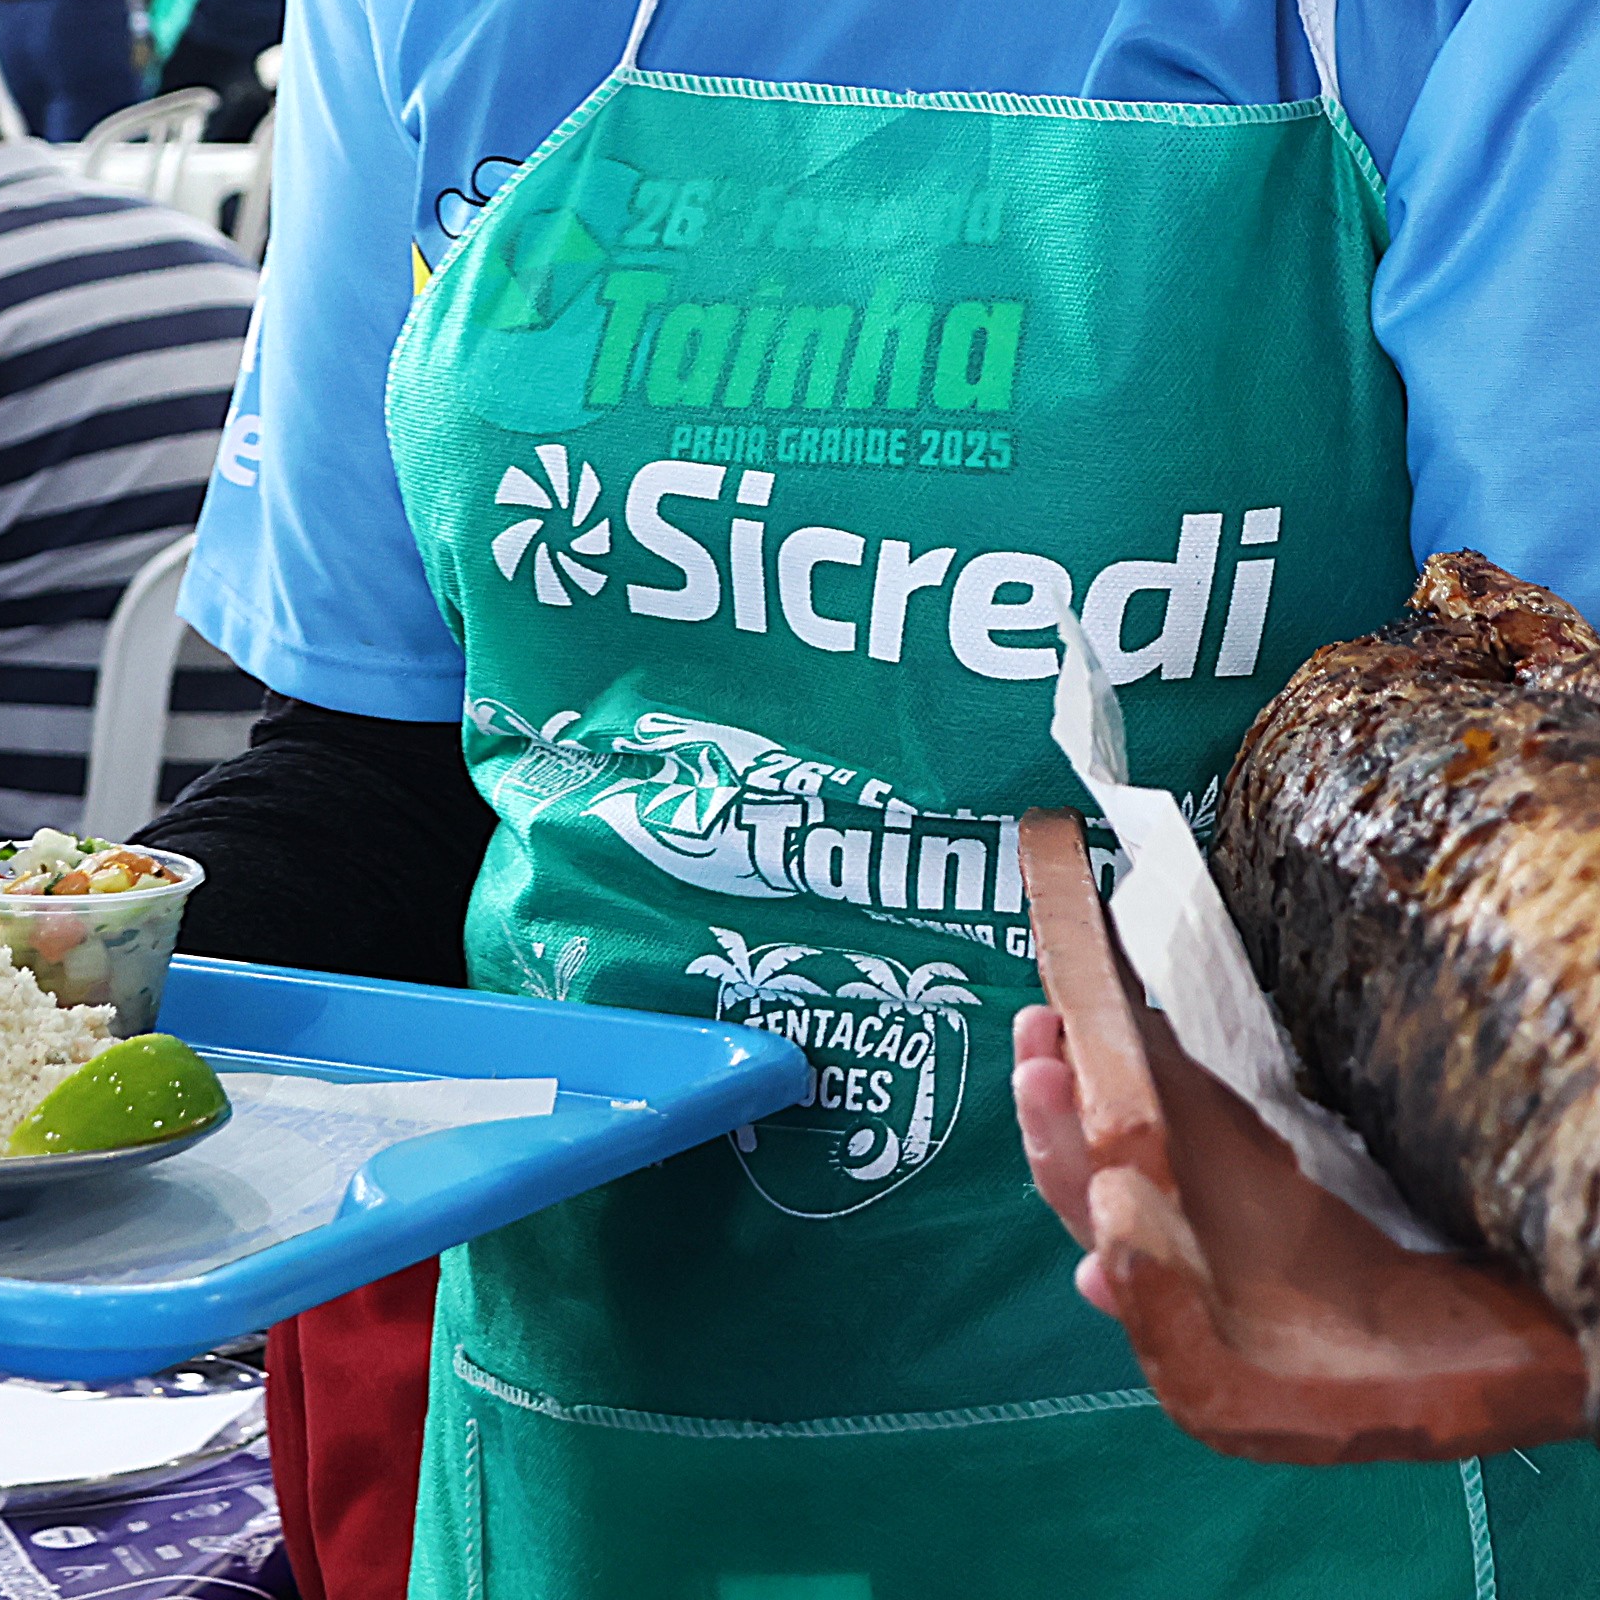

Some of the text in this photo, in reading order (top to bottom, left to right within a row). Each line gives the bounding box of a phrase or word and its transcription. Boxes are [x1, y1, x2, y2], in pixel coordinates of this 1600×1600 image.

[588, 269, 1026, 411] Tainha
[671, 425, 1013, 469] PRAIA GRANDE 2025
[624, 458, 1282, 686] Sicredi
